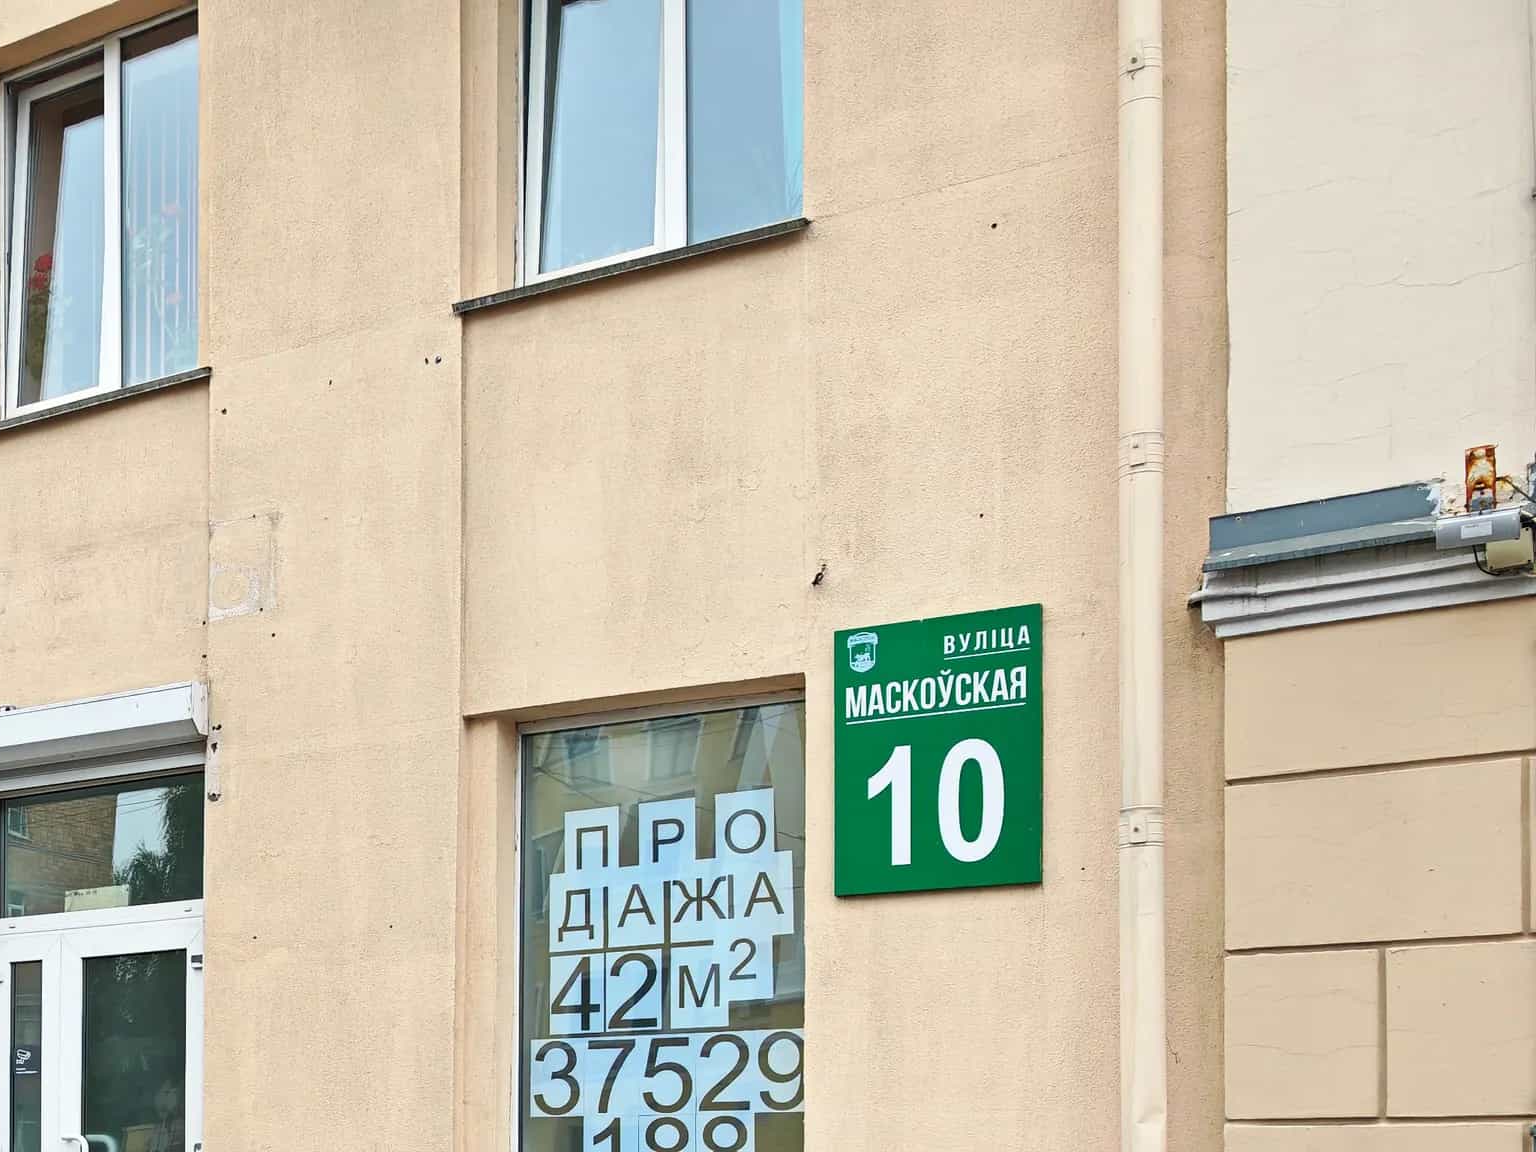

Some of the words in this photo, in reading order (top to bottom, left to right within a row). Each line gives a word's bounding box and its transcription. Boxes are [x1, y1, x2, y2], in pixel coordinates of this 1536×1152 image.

[943, 624, 1031, 655] ВУЛІЦА
[845, 665, 1027, 719] МАСКОЎСКАЯ
[867, 738, 1005, 866] 10
[576, 808, 767, 870] ПРО
[558, 871, 785, 942] ДАЖА
[533, 1031, 805, 1115] 37529
